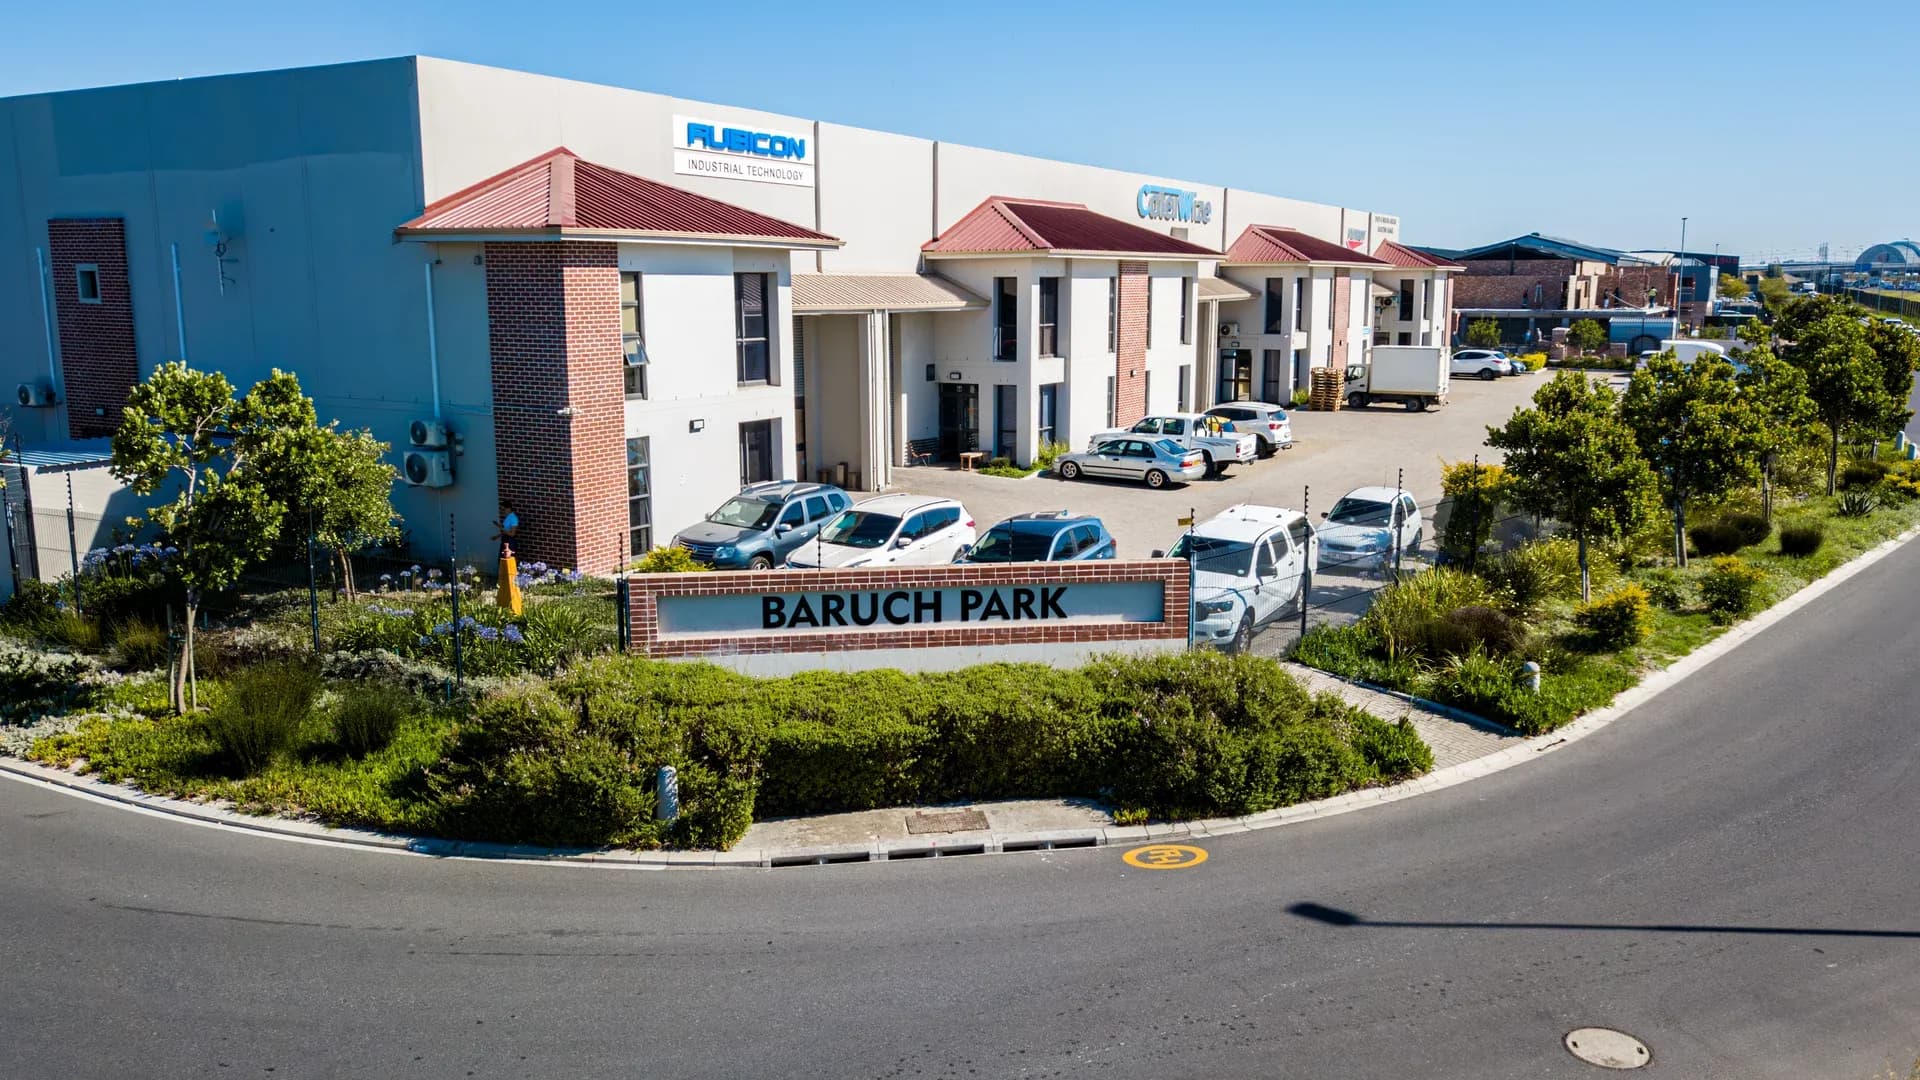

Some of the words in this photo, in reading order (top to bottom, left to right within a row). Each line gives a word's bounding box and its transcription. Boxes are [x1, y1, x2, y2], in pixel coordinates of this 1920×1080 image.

[687, 122, 806, 160] RUBICON
[688, 159, 744, 175] INDUSTRIAL
[747, 165, 804, 181] TECHNOLOGY
[762, 591, 943, 629] BARUCH
[960, 586, 1068, 622] PARK
